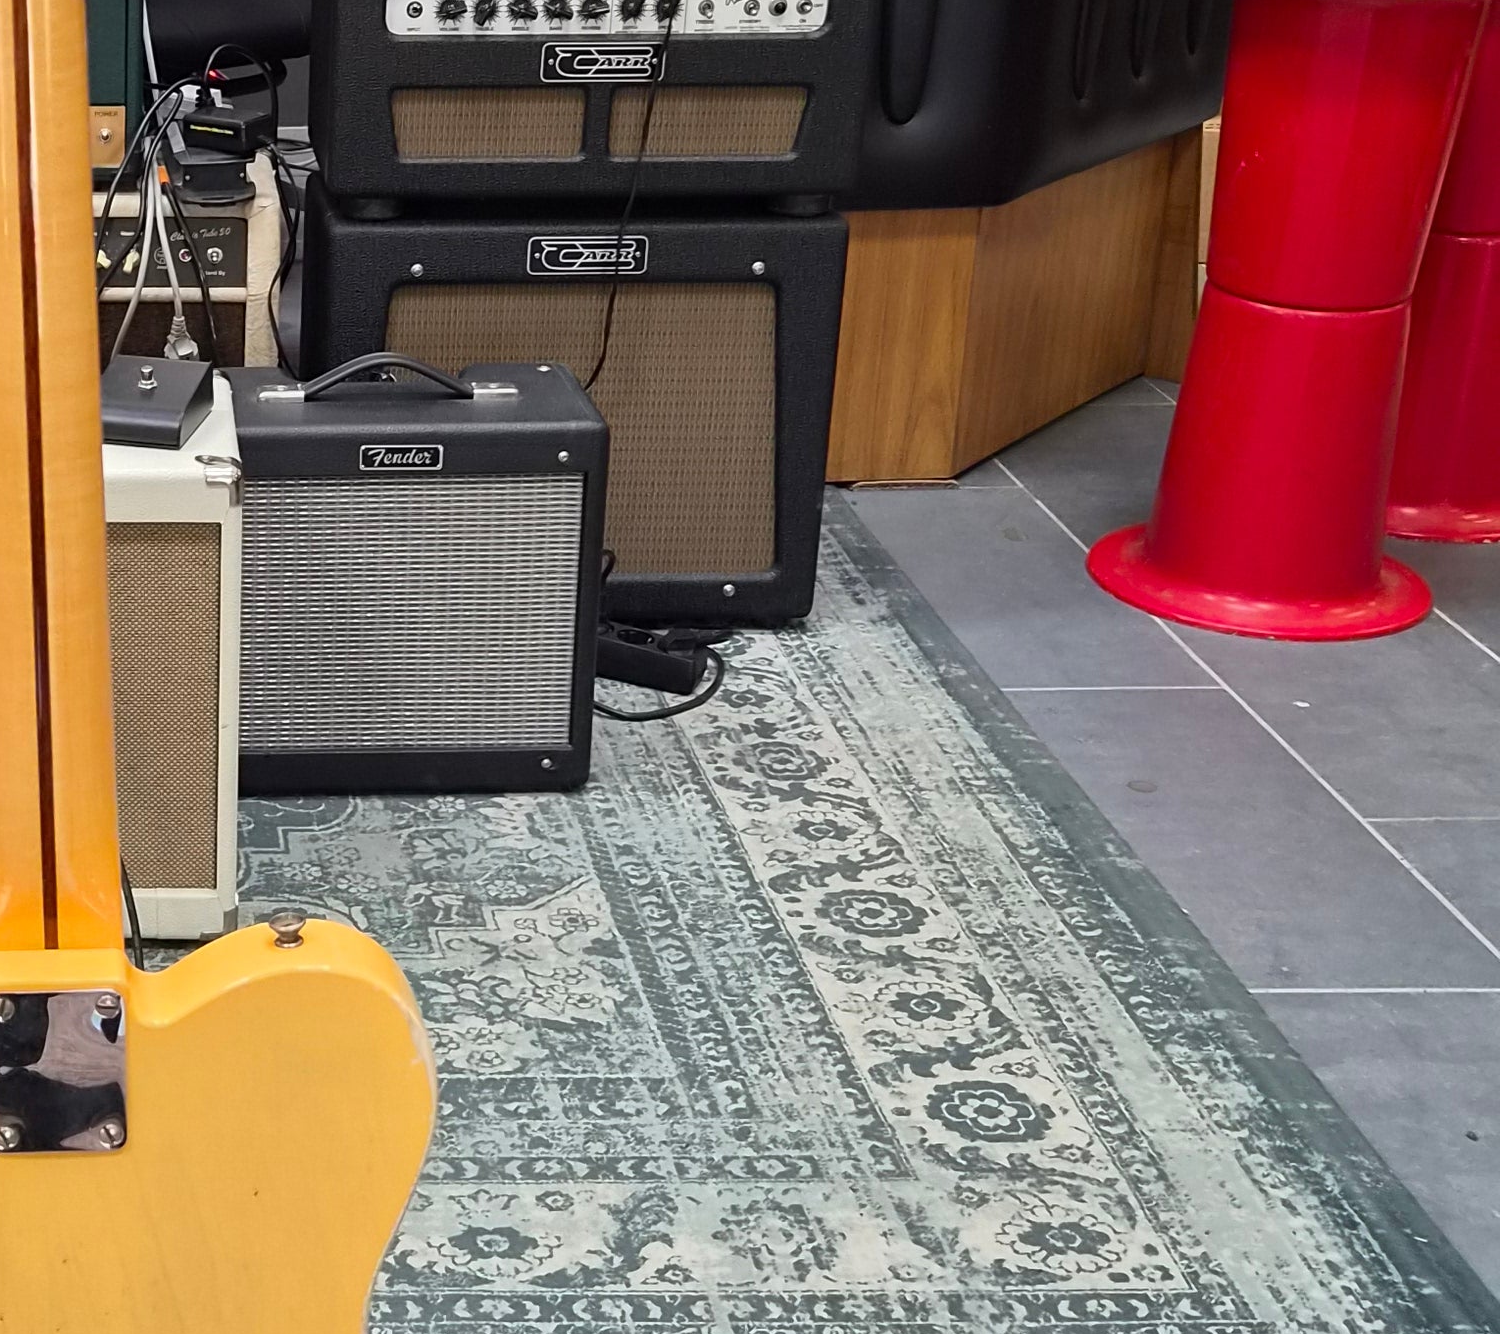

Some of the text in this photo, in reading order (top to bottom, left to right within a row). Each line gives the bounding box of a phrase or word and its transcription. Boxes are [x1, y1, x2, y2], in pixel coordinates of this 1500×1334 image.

[555, 46, 654, 77] CARR
[541, 240, 636, 271] CARR
[367, 448, 433, 467] Fender
